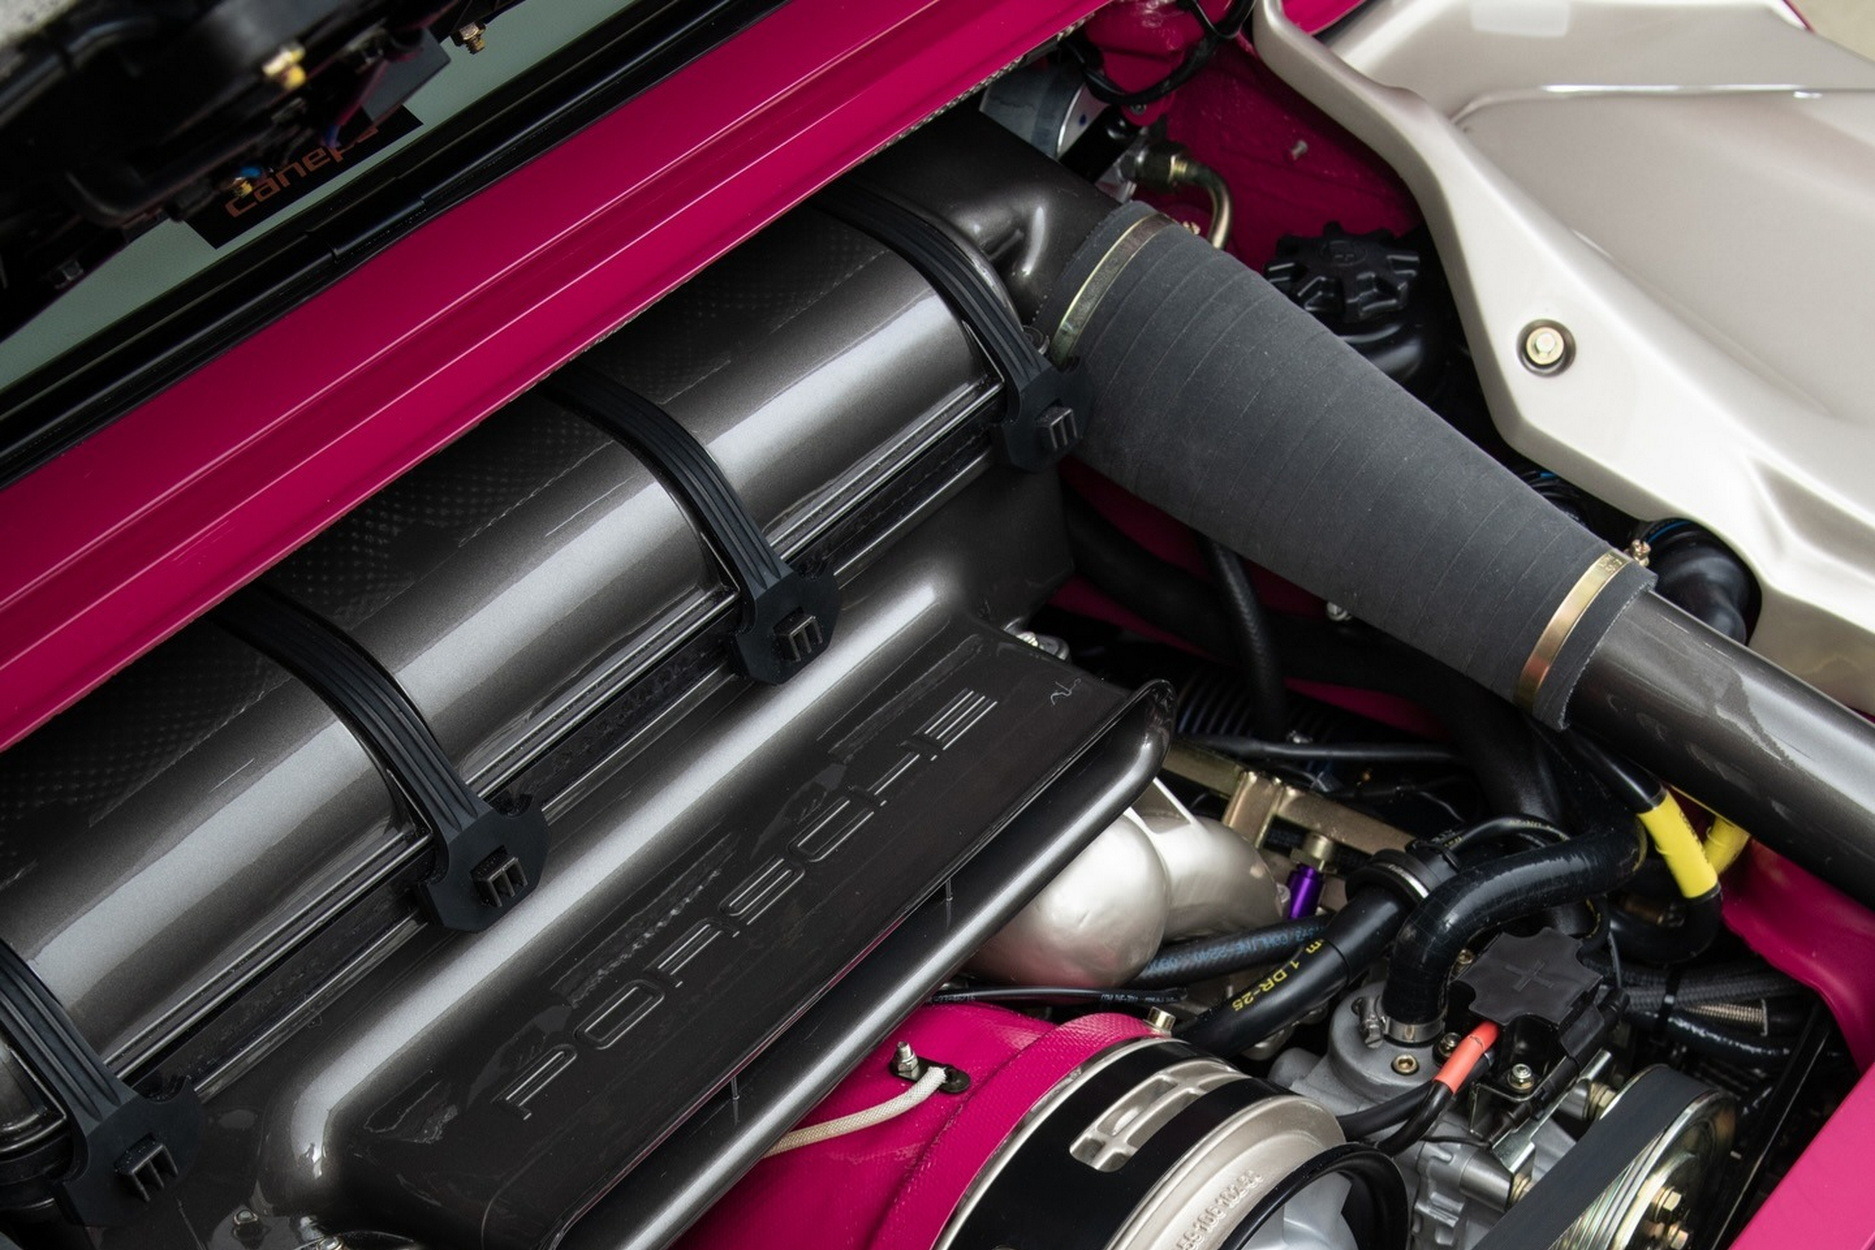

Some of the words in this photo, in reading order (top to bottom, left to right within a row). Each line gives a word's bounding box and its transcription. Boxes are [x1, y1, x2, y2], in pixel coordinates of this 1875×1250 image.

[223, 125, 379, 218] canep
[491, 687, 998, 1121] PORSCHE
[1229, 967, 1288, 1012] DR-25
